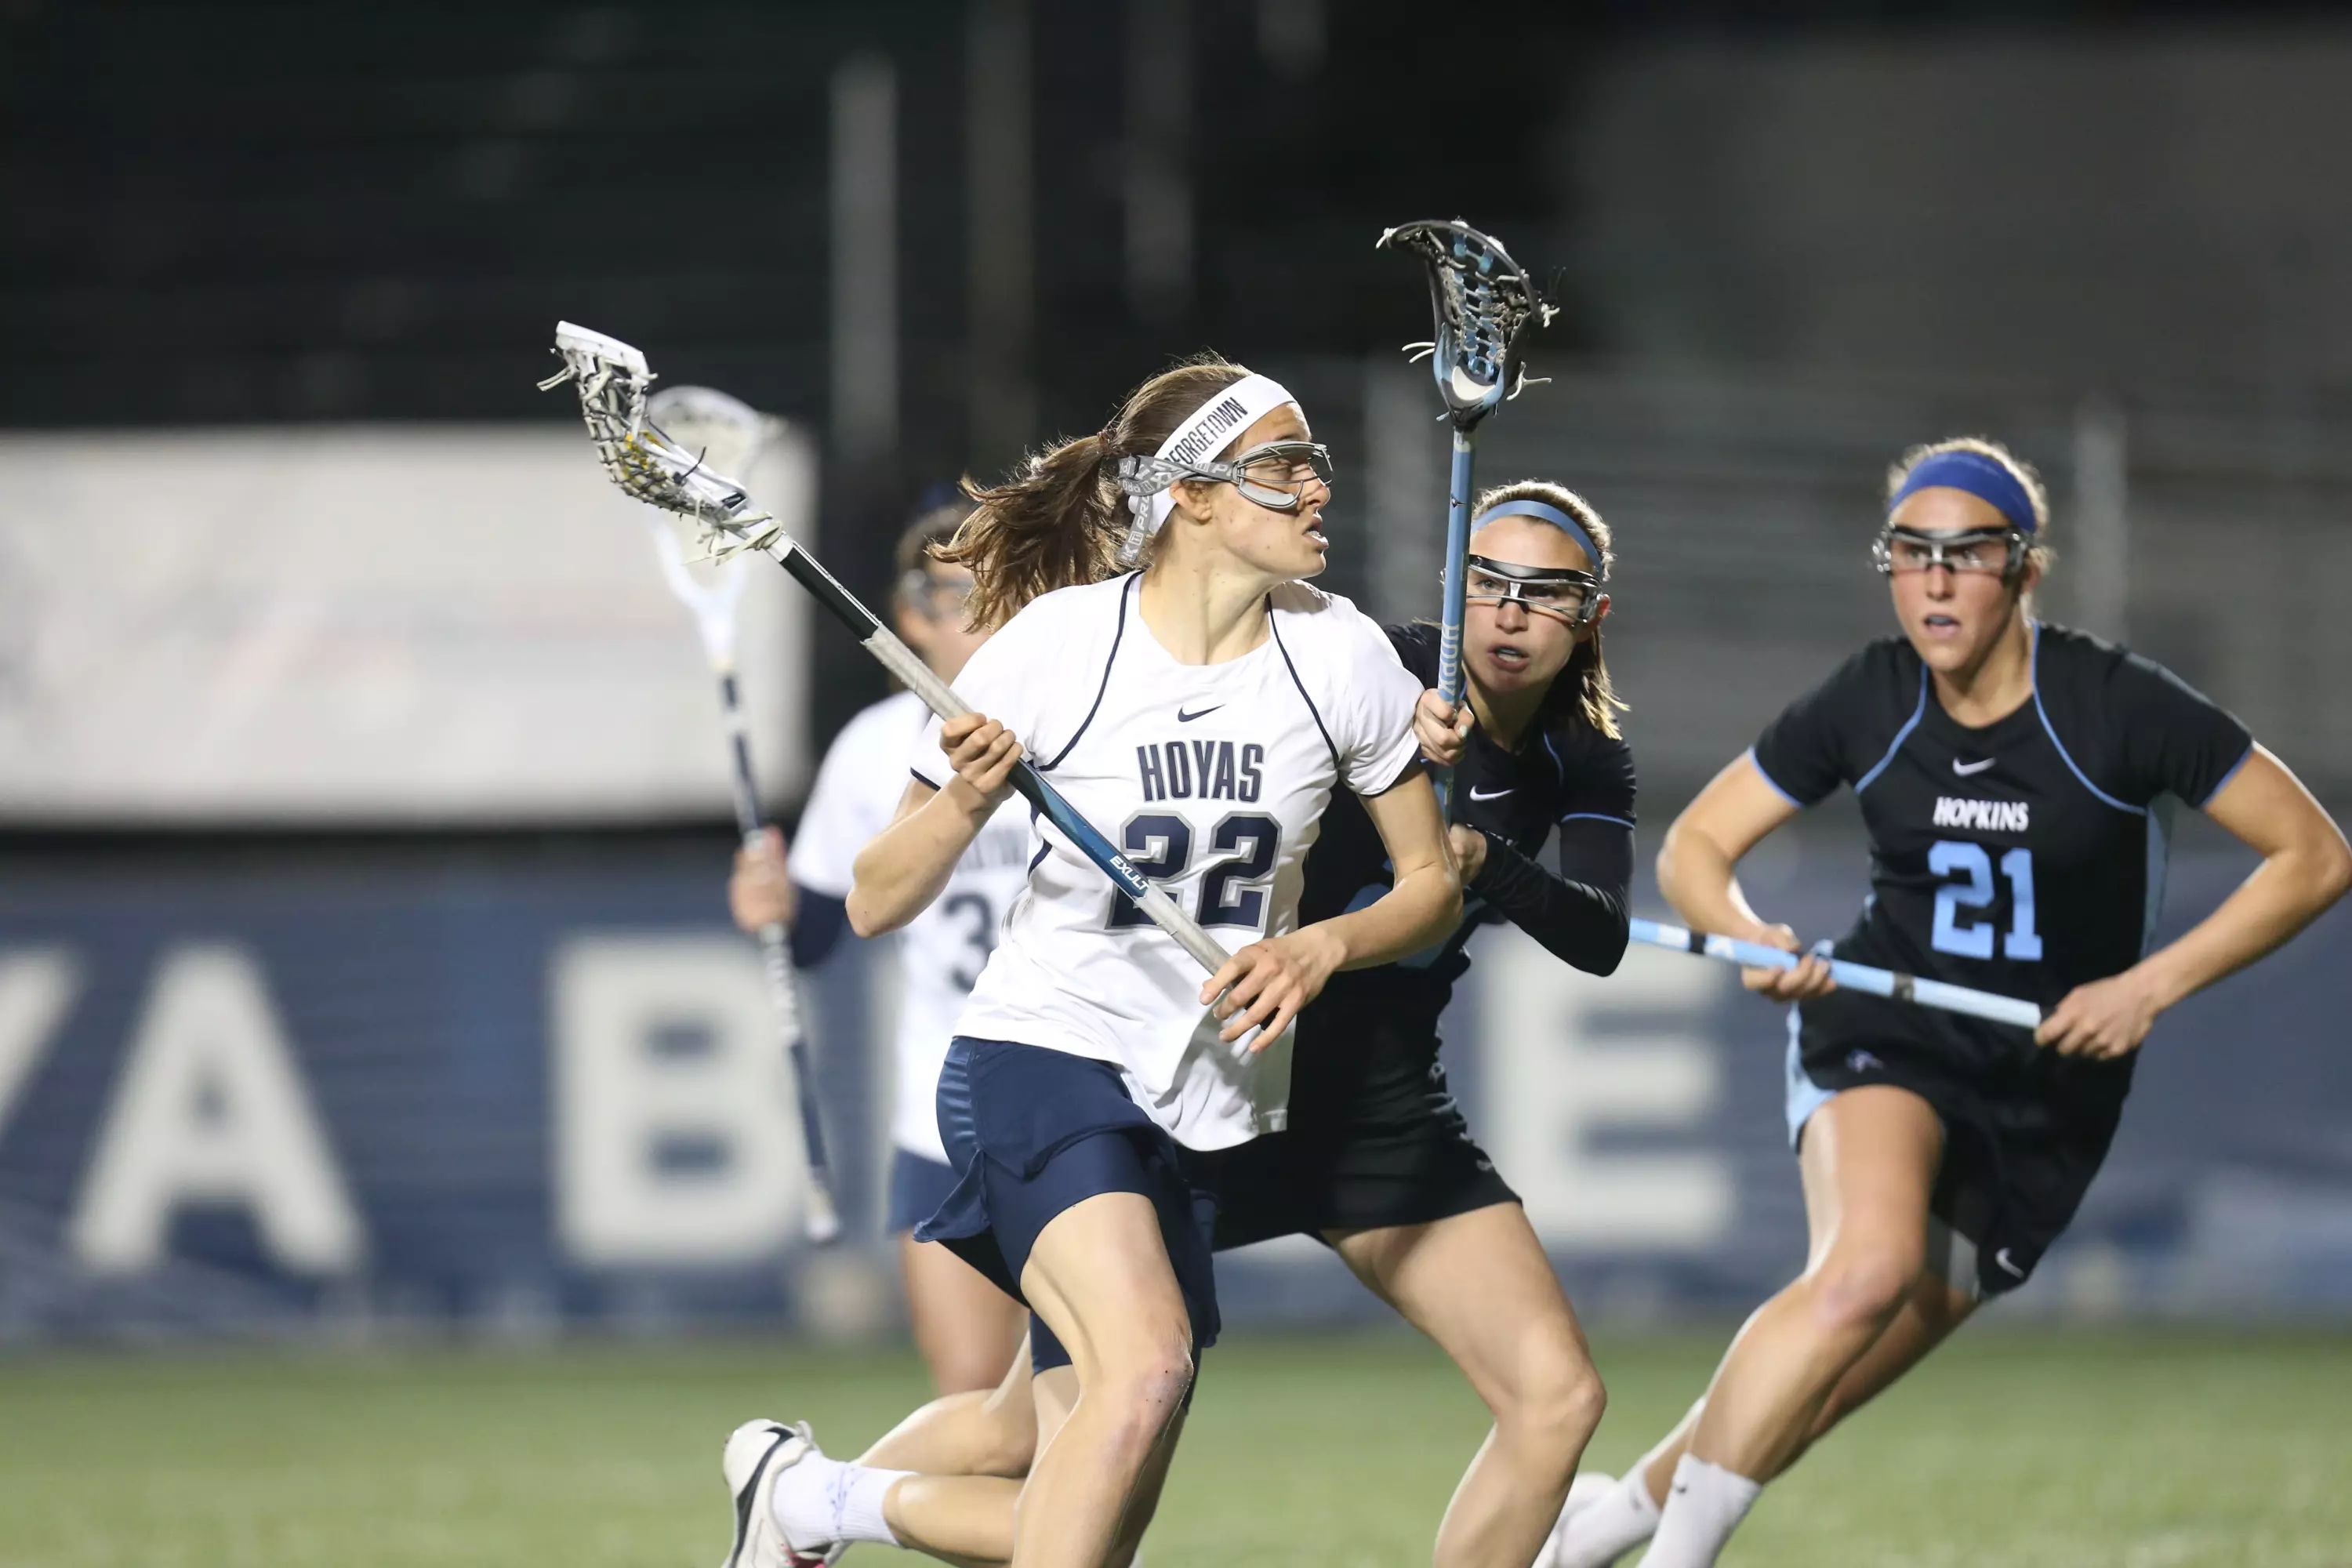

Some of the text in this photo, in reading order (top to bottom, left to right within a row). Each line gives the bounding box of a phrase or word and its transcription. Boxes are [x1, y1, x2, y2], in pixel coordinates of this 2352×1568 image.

[1163, 397, 1248, 465] EORGETOWN
[1438, 623, 1460, 704] HOPK
[1136, 739, 1265, 803] HOYAS
[1933, 796, 2030, 831] HOPKINS
[1105, 810, 1283, 933] 22
[1109, 855, 1150, 891] EXULT
[1927, 840, 2043, 961] 21
